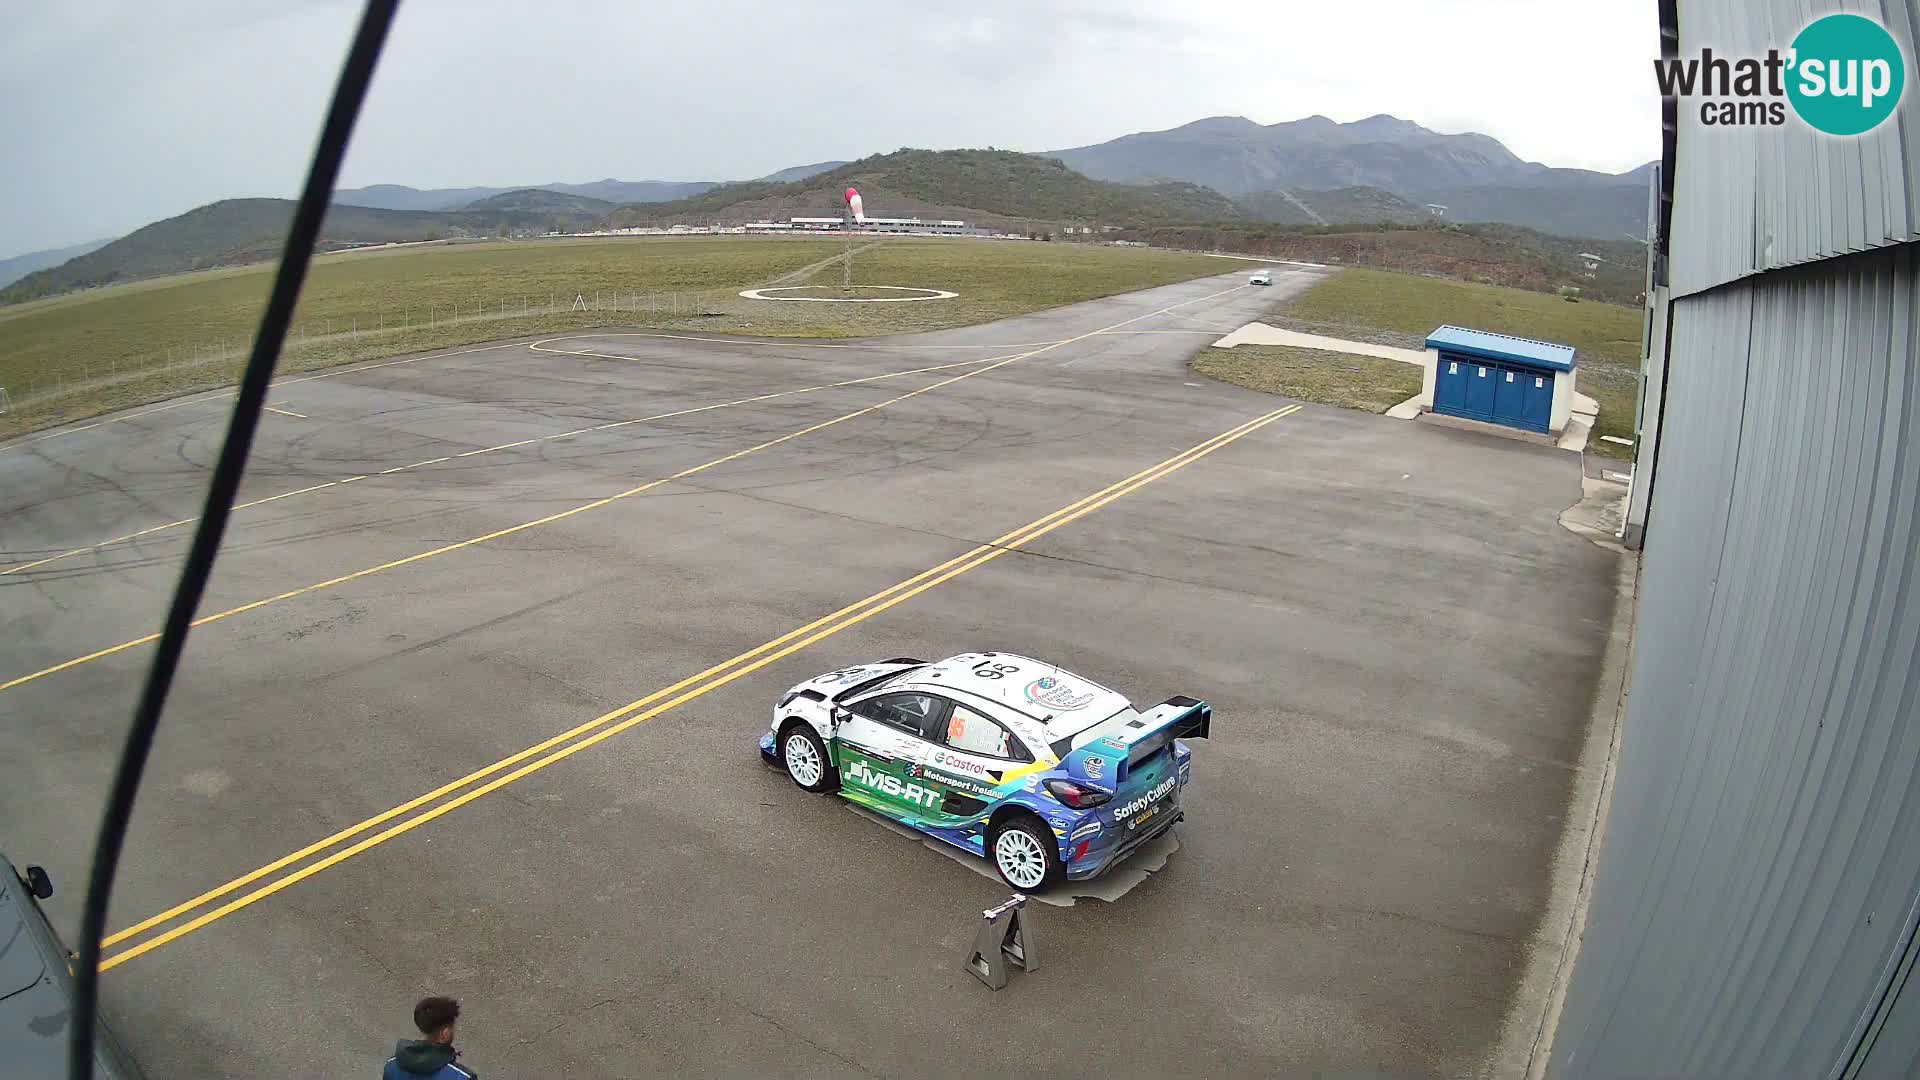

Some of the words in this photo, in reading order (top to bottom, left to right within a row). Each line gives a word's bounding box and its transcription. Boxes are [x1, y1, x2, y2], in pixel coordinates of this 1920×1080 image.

[945, 755, 985, 775] Castrol
[861, 768, 941, 808] MS-RT
[923, 769, 972, 792] Motorsport
[970, 784, 1005, 800] Ireland
[1113, 776, 1177, 822] SafetyCulture
